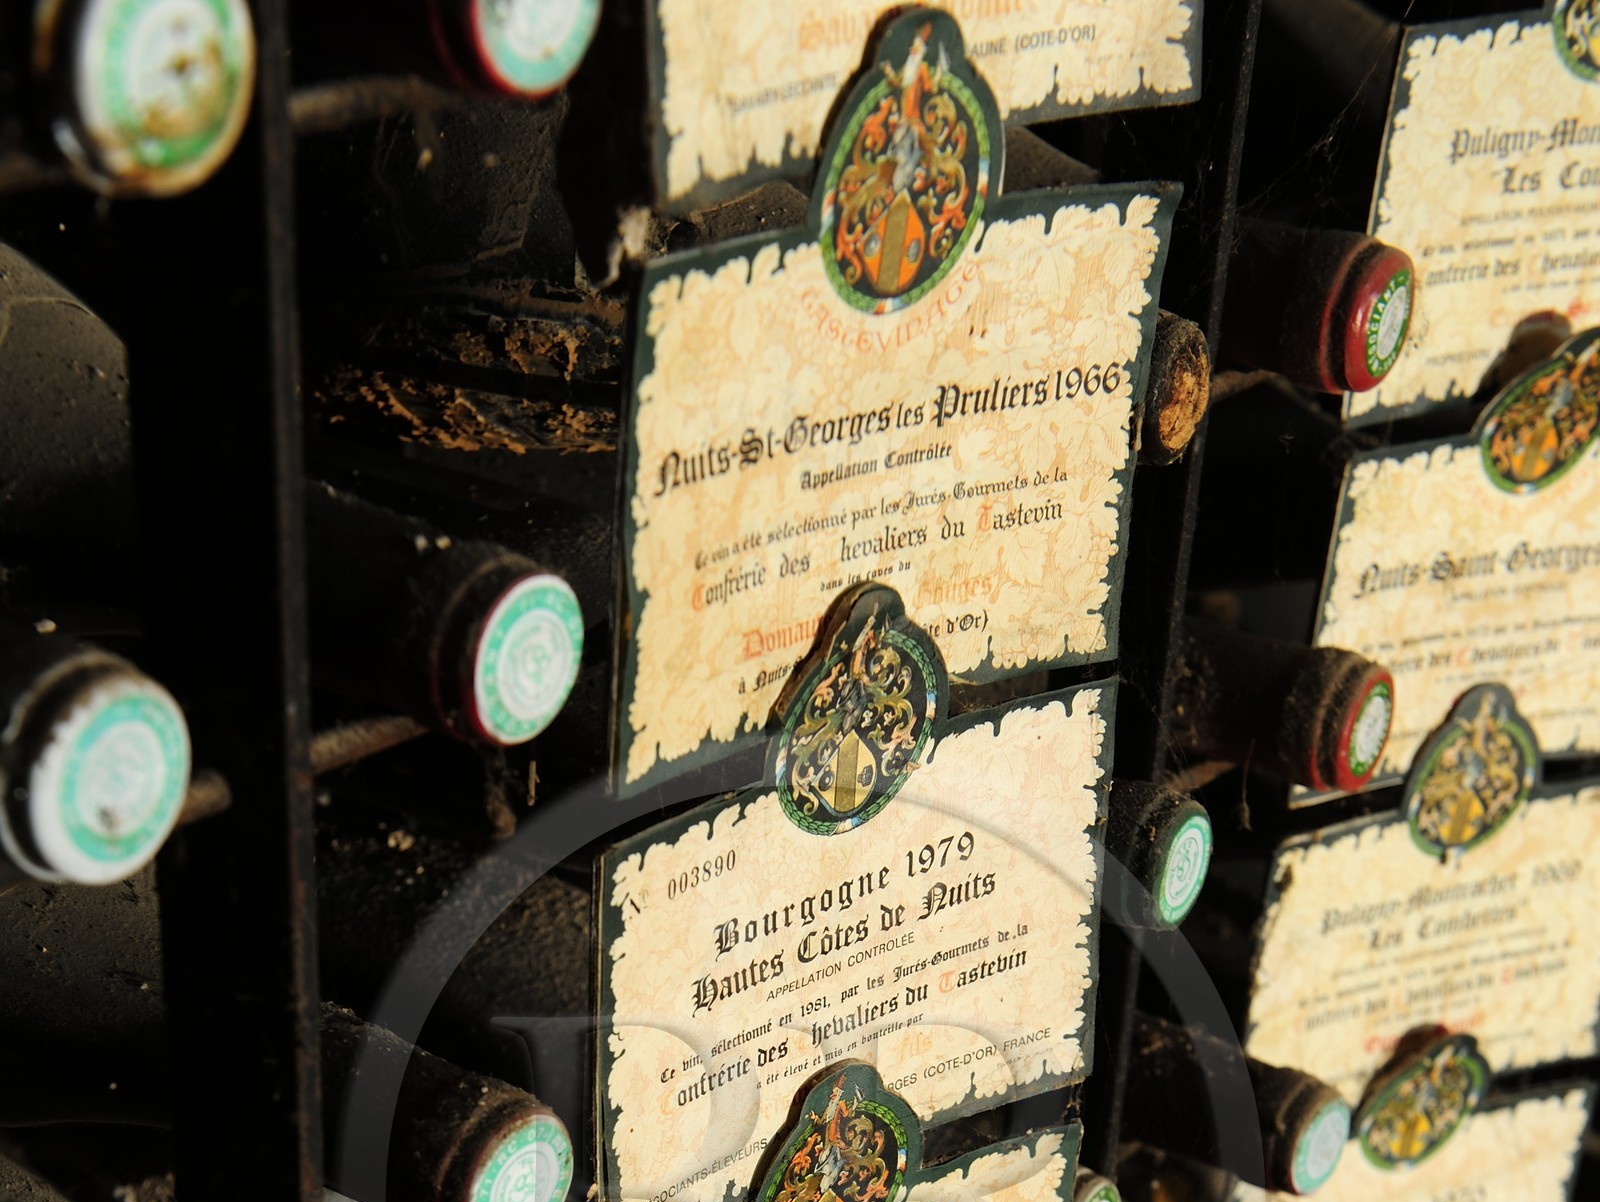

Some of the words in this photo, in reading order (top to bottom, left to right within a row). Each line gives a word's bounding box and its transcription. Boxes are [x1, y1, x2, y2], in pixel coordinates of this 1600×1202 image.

[896, 402, 925, 428] les
[1054, 362, 1121, 401] 1966
[800, 459, 878, 490] Appellation
[851, 506, 877, 530] par
[880, 498, 900, 515] les
[1033, 470, 1050, 485] de
[1053, 467, 1068, 482] la
[779, 552, 811, 577] des
[941, 515, 965, 540] du
[899, 560, 911, 571] du
[668, 849, 736, 901] 003890
[713, 865, 890, 962] Bourgogne
[906, 831, 975, 878] 1979
[691, 949, 785, 1018] Hautes
[797, 914, 869, 963] Côtes
[880, 904, 906, 932] de
[917, 872, 996, 922] Nuits
[766, 960, 842, 1003] APPELLATION
[847, 931, 915, 967] CONTROLÉE
[660, 1067, 676, 1083] Ce
[710, 1019, 772, 1058] sélectionné
[779, 1013, 792, 1027] en
[801, 995, 831, 1018] 1981,
[840, 984, 860, 1004] par
[867, 976, 885, 990] les
[892, 935, 990, 984] Jurés-Gourmets
[997, 930, 1010, 943] de
[1017, 923, 1028, 936] la
[757, 1037, 789, 1067] des
[905, 983, 929, 1006] du
[766, 1073, 779, 1085] été
[784, 1057, 808, 1079] élevé
[812, 1056, 822, 1066] et
[825, 1047, 843, 1061] mis
[847, 1041, 857, 1052] en
[861, 1021, 904, 1045] bouteille
[906, 1013, 924, 1027] par
[923, 1044, 997, 1079] (COTE-D'OR)
[1003, 1027, 1051, 1051] FRANCE
